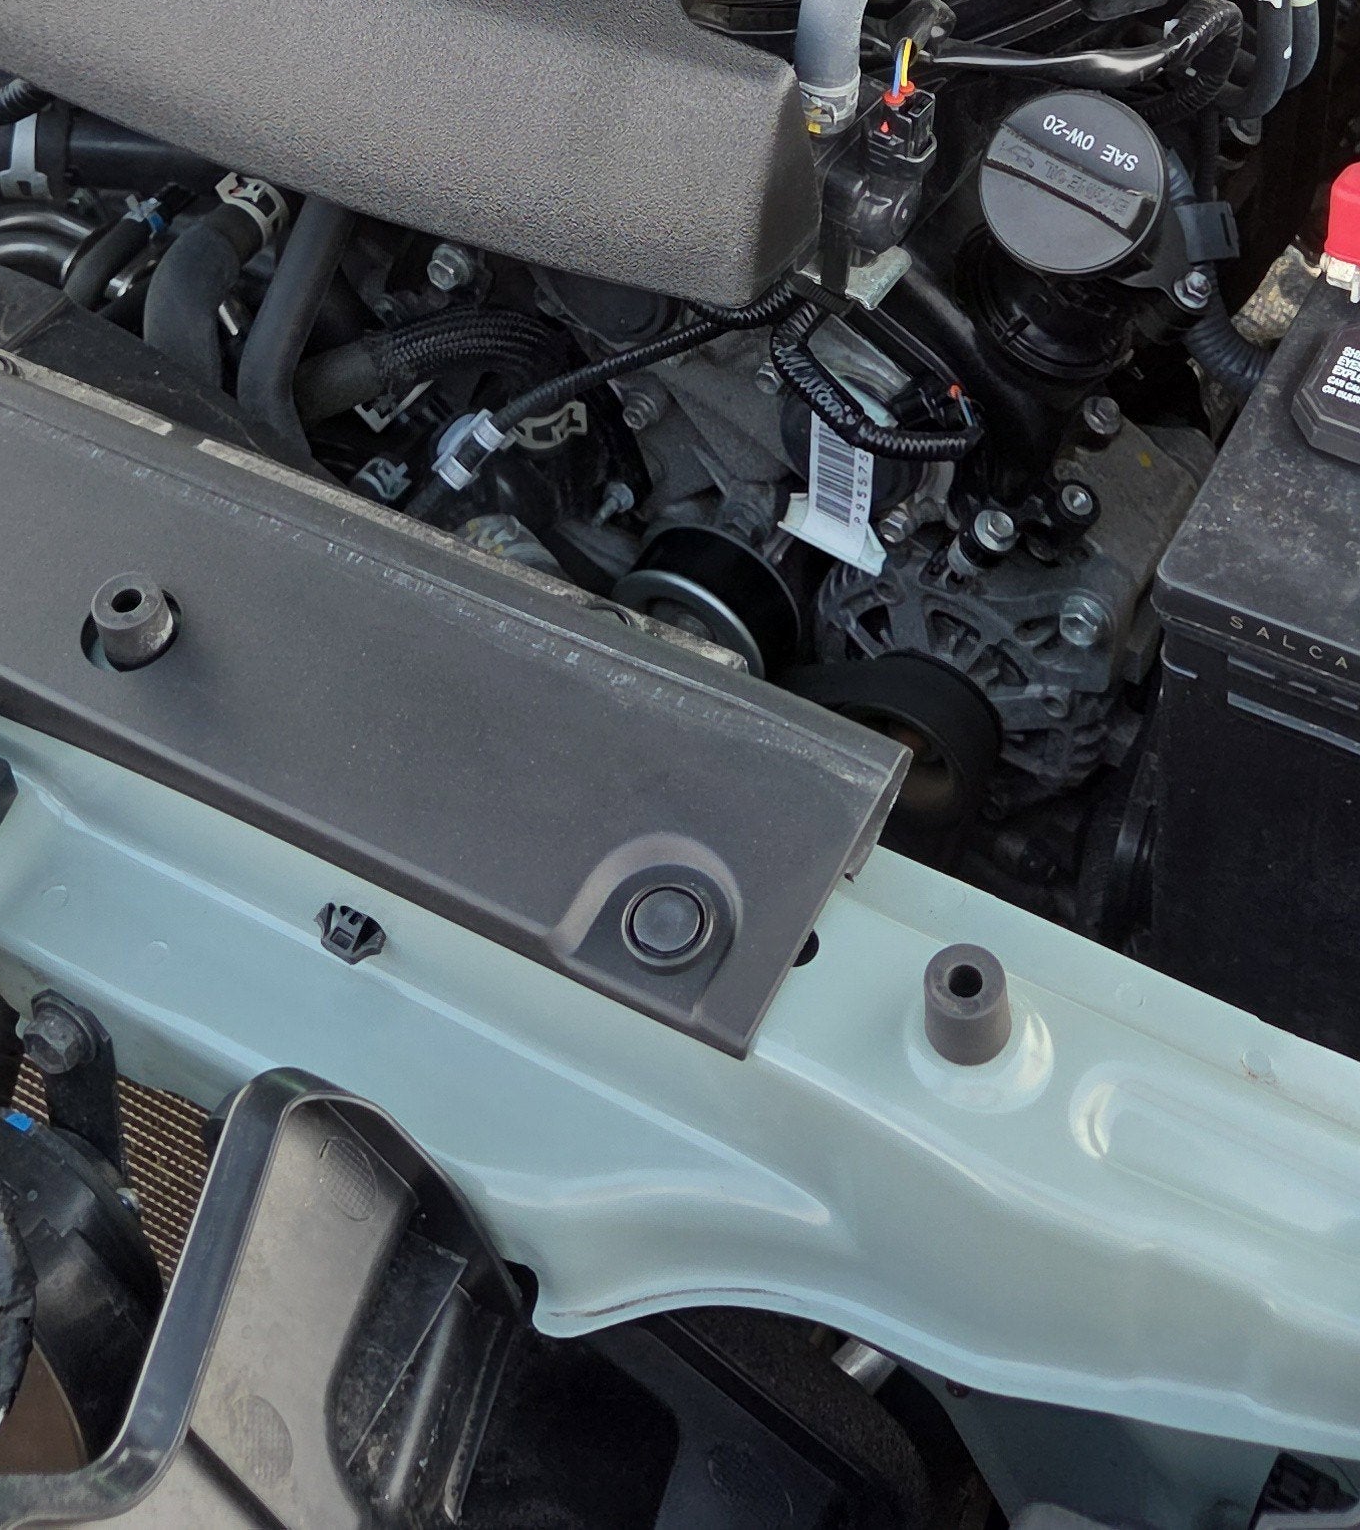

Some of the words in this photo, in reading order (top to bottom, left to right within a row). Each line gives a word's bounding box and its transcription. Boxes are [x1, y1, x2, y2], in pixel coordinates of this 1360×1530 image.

[1043, 114, 1095, 151] 0W-20
[1100, 144, 1139, 172] SAE
[1230, 615, 1348, 669] SALCA
